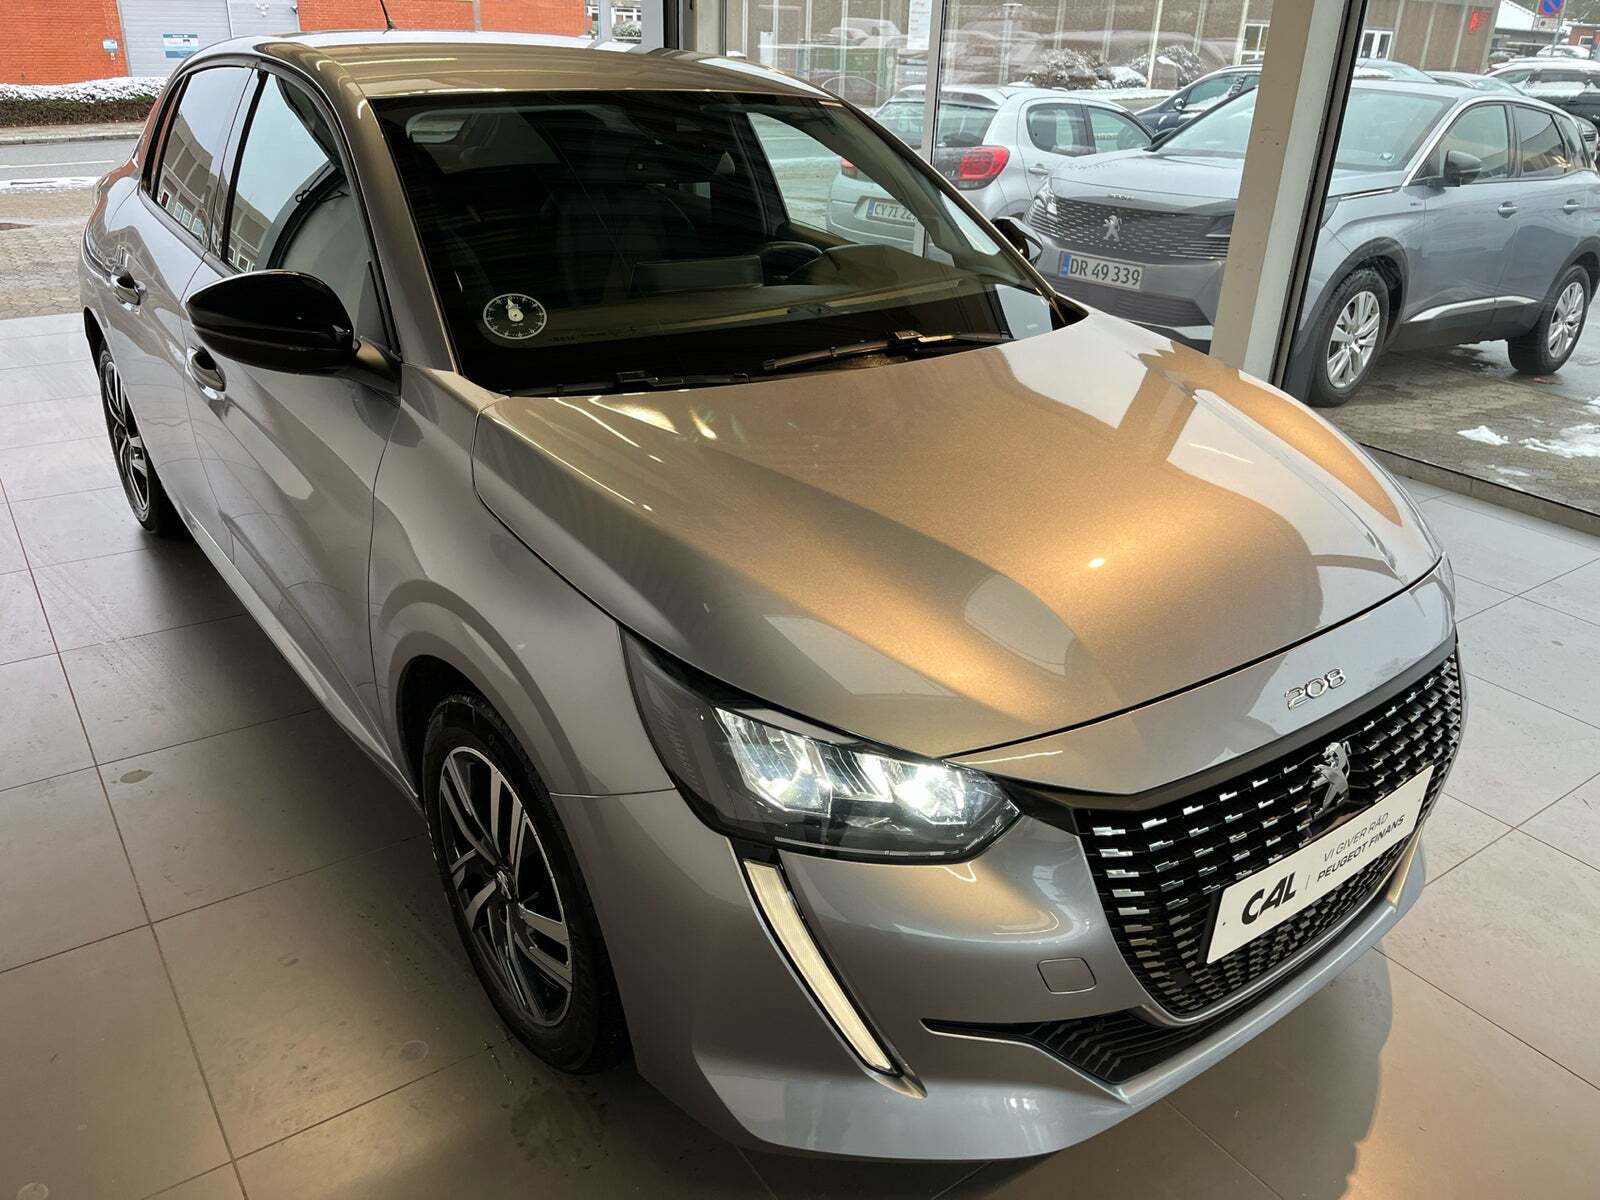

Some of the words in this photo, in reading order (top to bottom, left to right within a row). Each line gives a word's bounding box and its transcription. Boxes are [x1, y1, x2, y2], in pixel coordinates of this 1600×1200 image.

[875, 203, 888, 216] CY
[1070, 258, 1088, 277] DR
[1091, 263, 1109, 281] 49
[1112, 266, 1140, 286] 339
[1285, 668, 1346, 711] 208
[1317, 841, 1369, 882] PEUGEOT
[1369, 814, 1405, 847] FINANS
[1324, 848, 1335, 861] VI
[1336, 827, 1367, 854] GIVER
[1241, 872, 1297, 926] CAL
